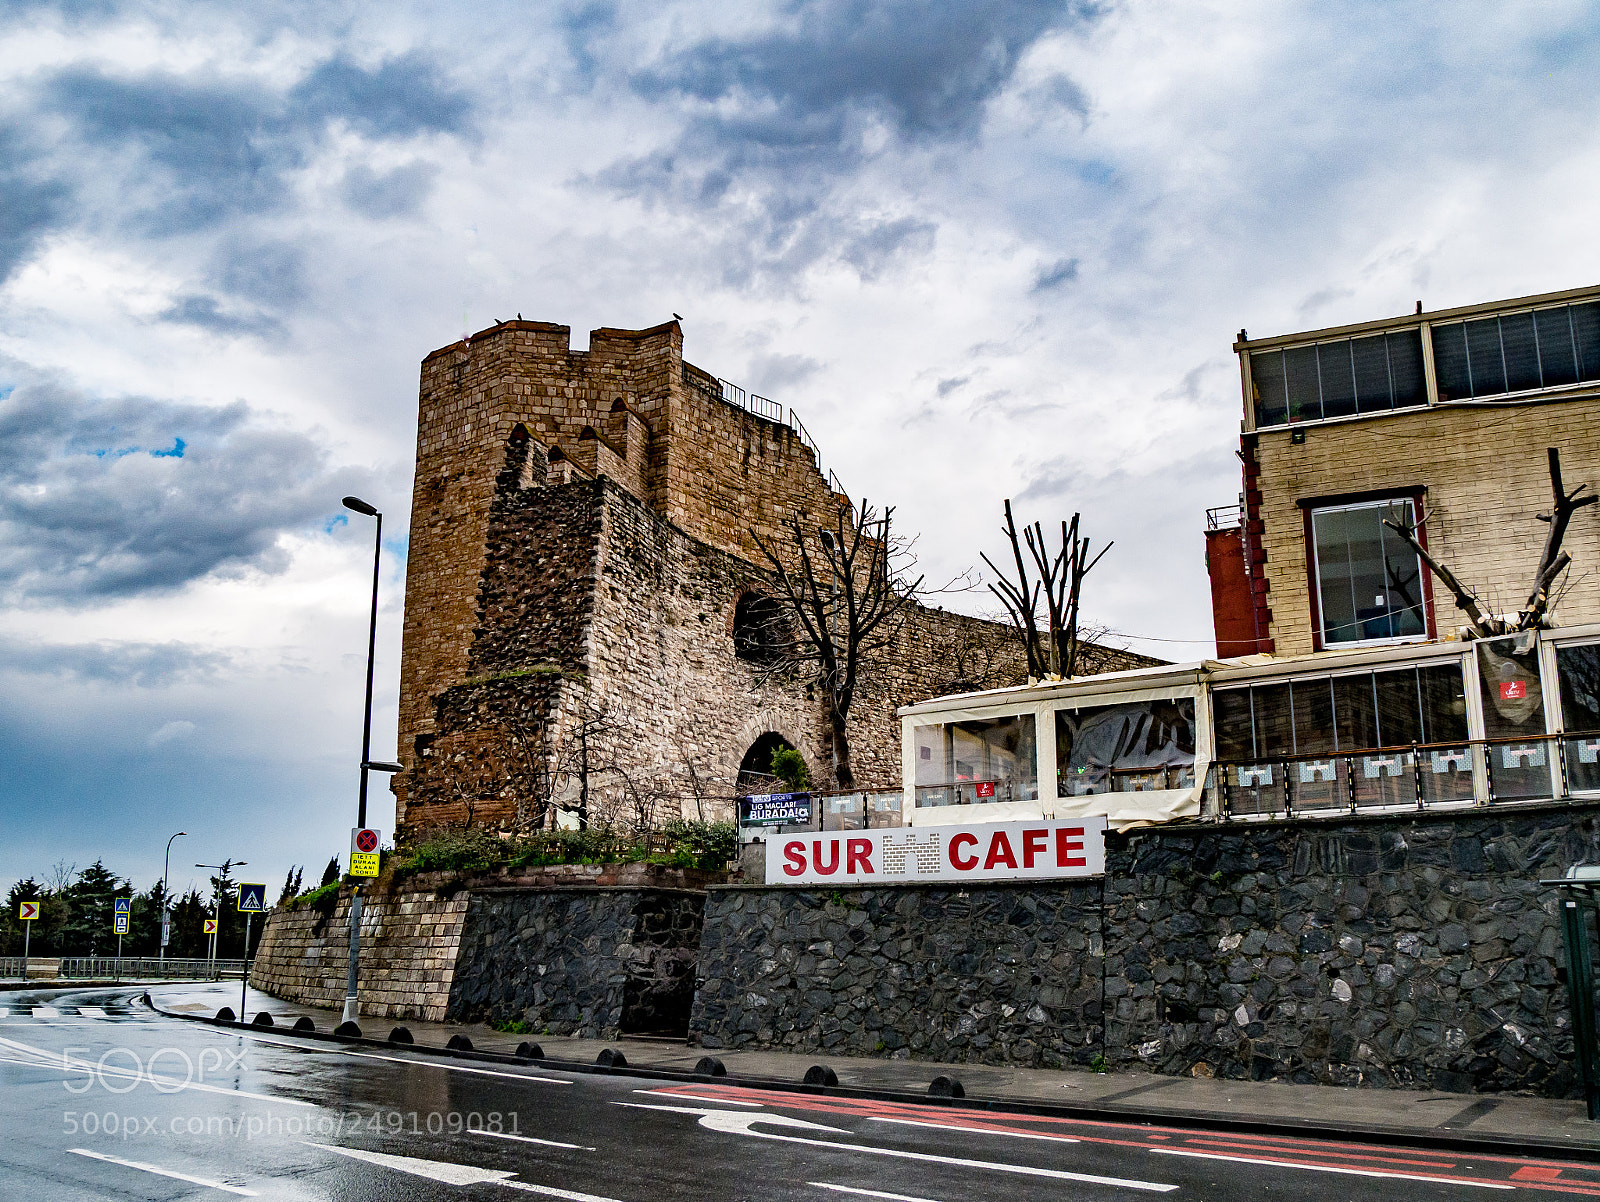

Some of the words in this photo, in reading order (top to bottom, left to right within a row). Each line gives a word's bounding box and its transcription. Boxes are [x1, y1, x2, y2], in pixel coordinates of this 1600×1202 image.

[750, 808, 799, 820] BURADA!
[782, 838, 875, 877] SUR
[948, 827, 1087, 871] CAFE
